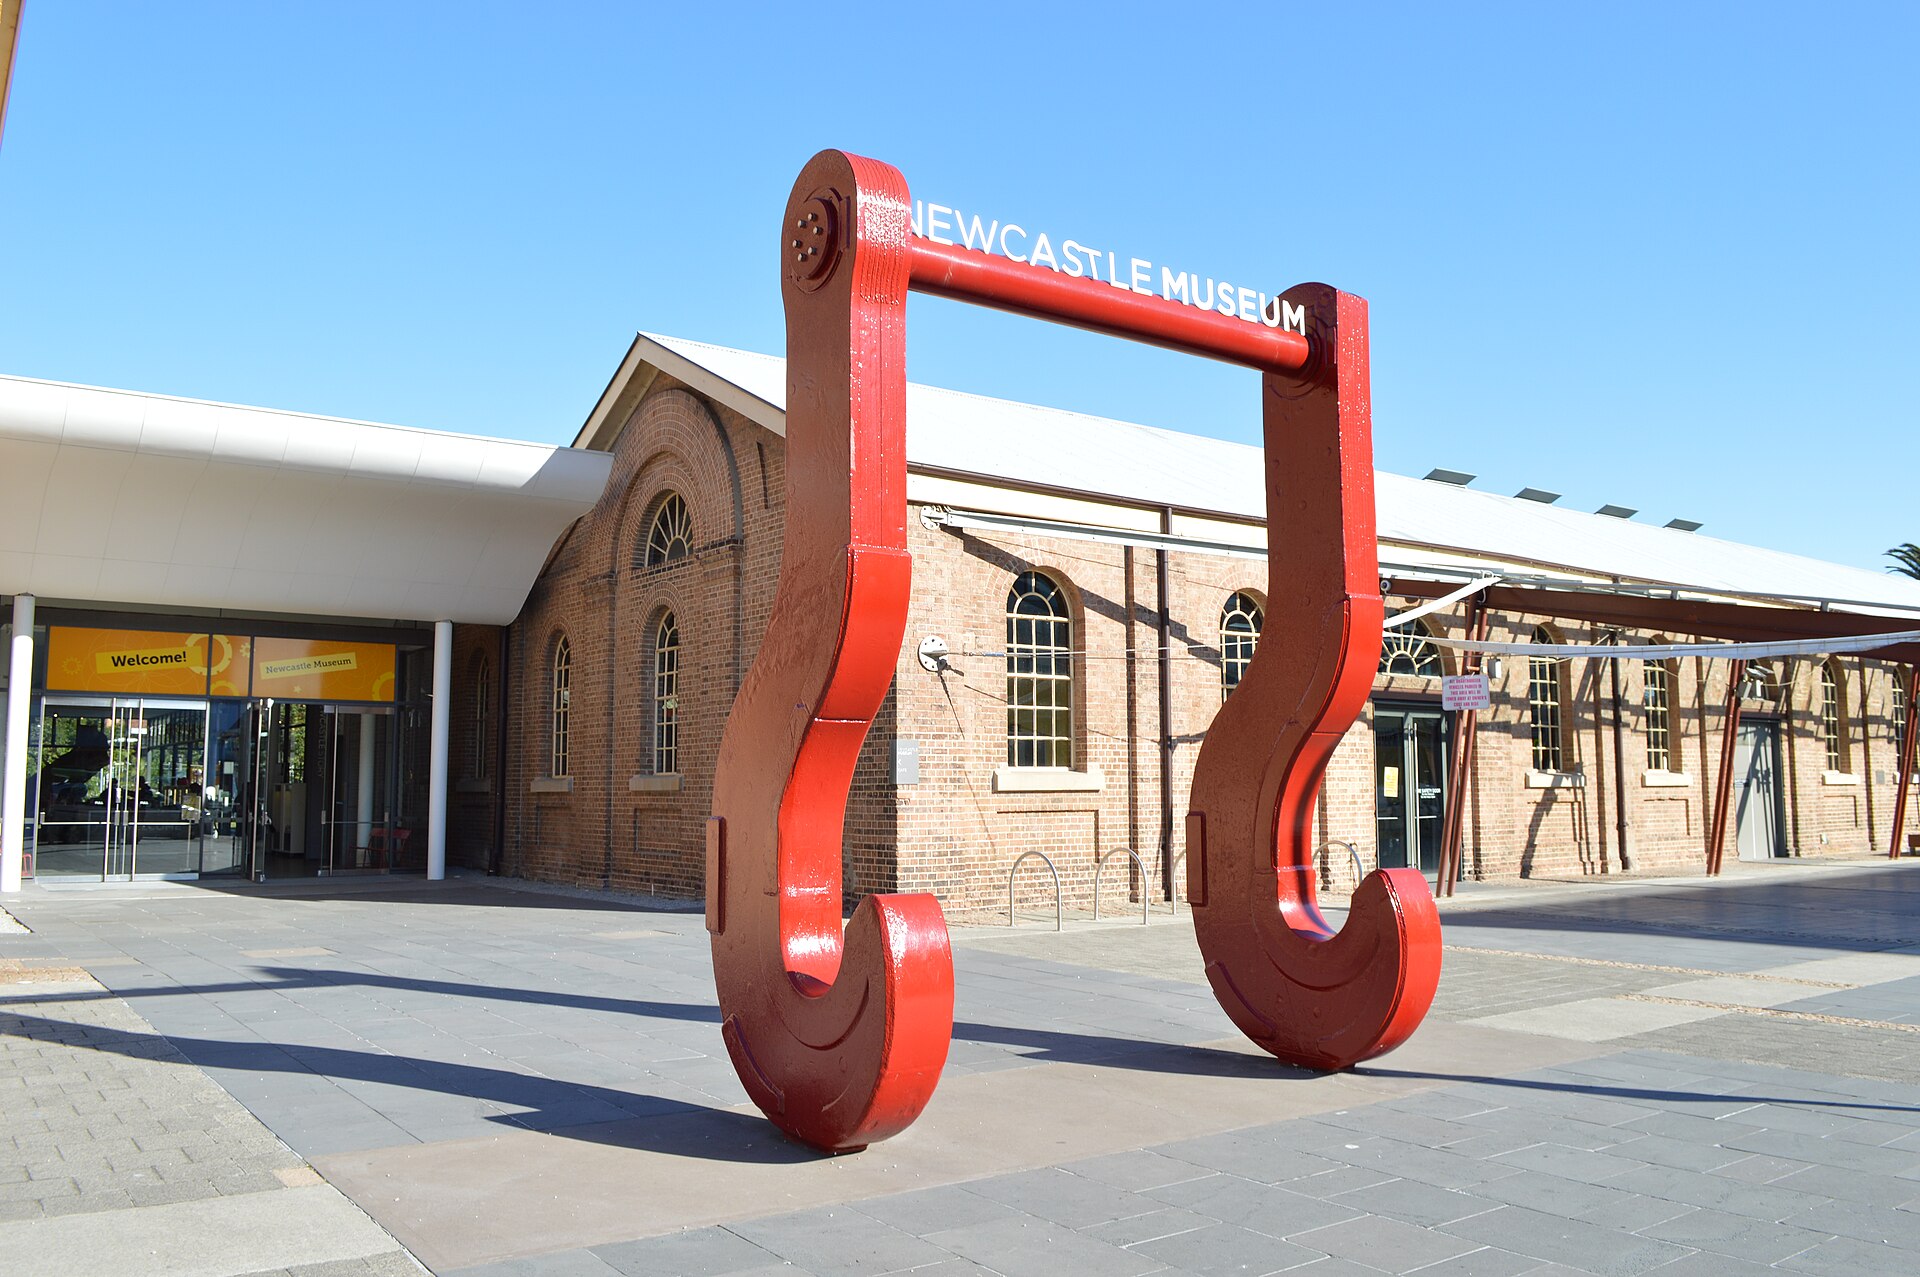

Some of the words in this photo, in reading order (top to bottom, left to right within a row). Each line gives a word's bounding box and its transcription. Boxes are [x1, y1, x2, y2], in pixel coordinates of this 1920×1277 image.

[1161, 266, 1306, 336] MUSEUM
[111, 651, 188, 667] Welcome!
[265, 662, 312, 674] Newcastle
[313, 657, 352, 669] Museum
